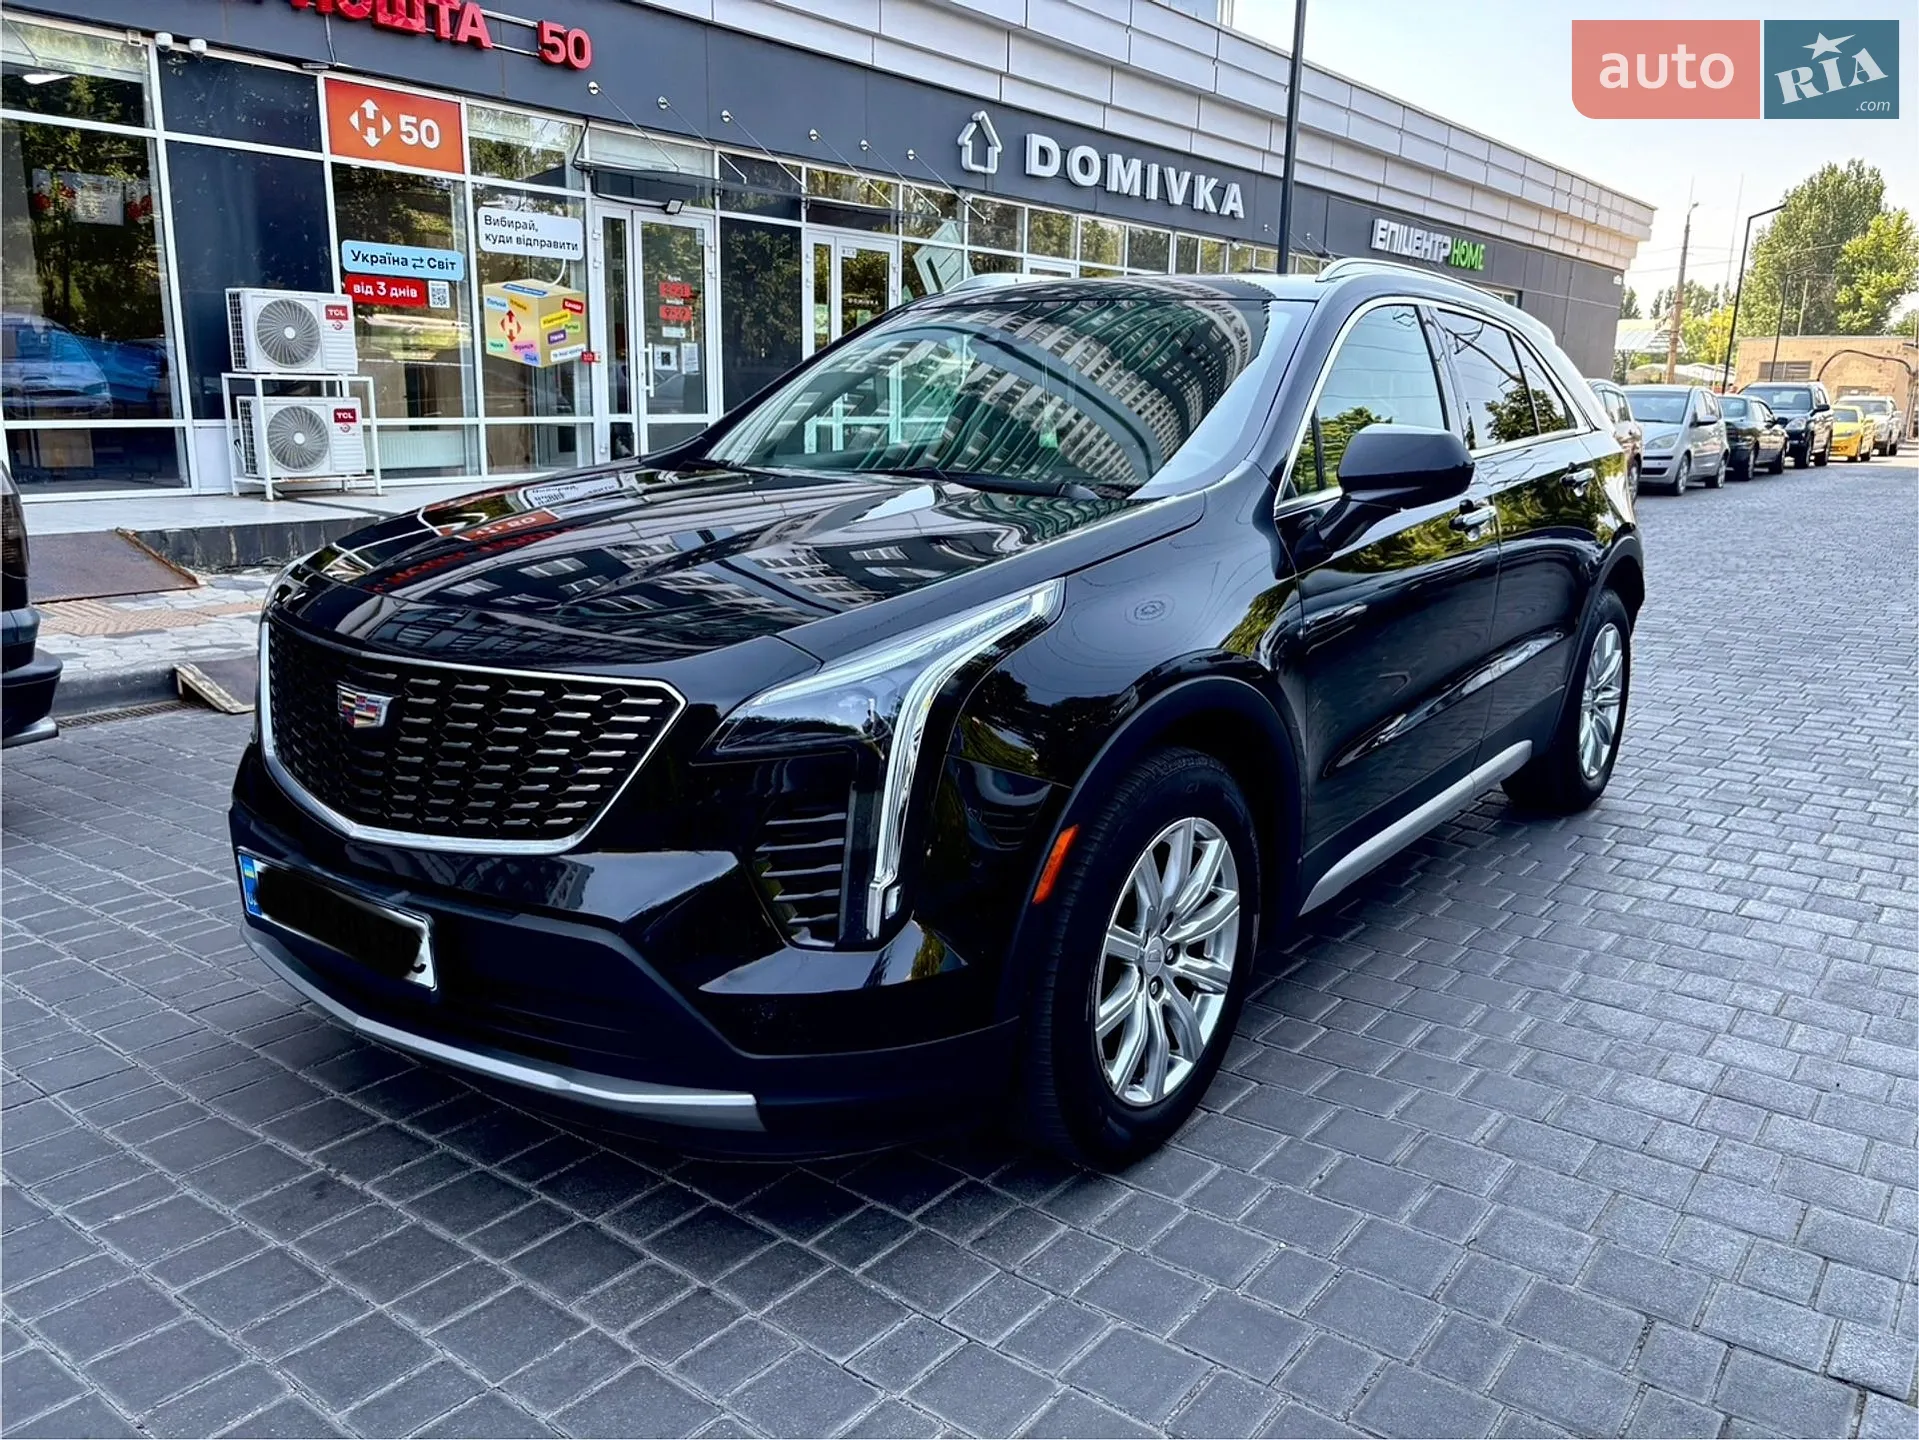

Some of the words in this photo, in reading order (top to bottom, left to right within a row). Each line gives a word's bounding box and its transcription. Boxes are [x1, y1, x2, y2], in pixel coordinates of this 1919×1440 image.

[537, 20, 593, 70] 50
[399, 113, 440, 149] 50
[1025, 132, 1245, 219] DOMIVKA
[484, 214, 539, 232] Вибирай,
[485, 232, 513, 245] куди
[516, 234, 578, 251] відправити
[351, 249, 409, 266] Україна
[427, 257, 457, 270] Світ
[353, 282, 374, 296] від
[376, 281, 387, 296] 3
[390, 285, 418, 298] днів
[328, 309, 346, 317] TCL
[336, 411, 354, 420] TCL
